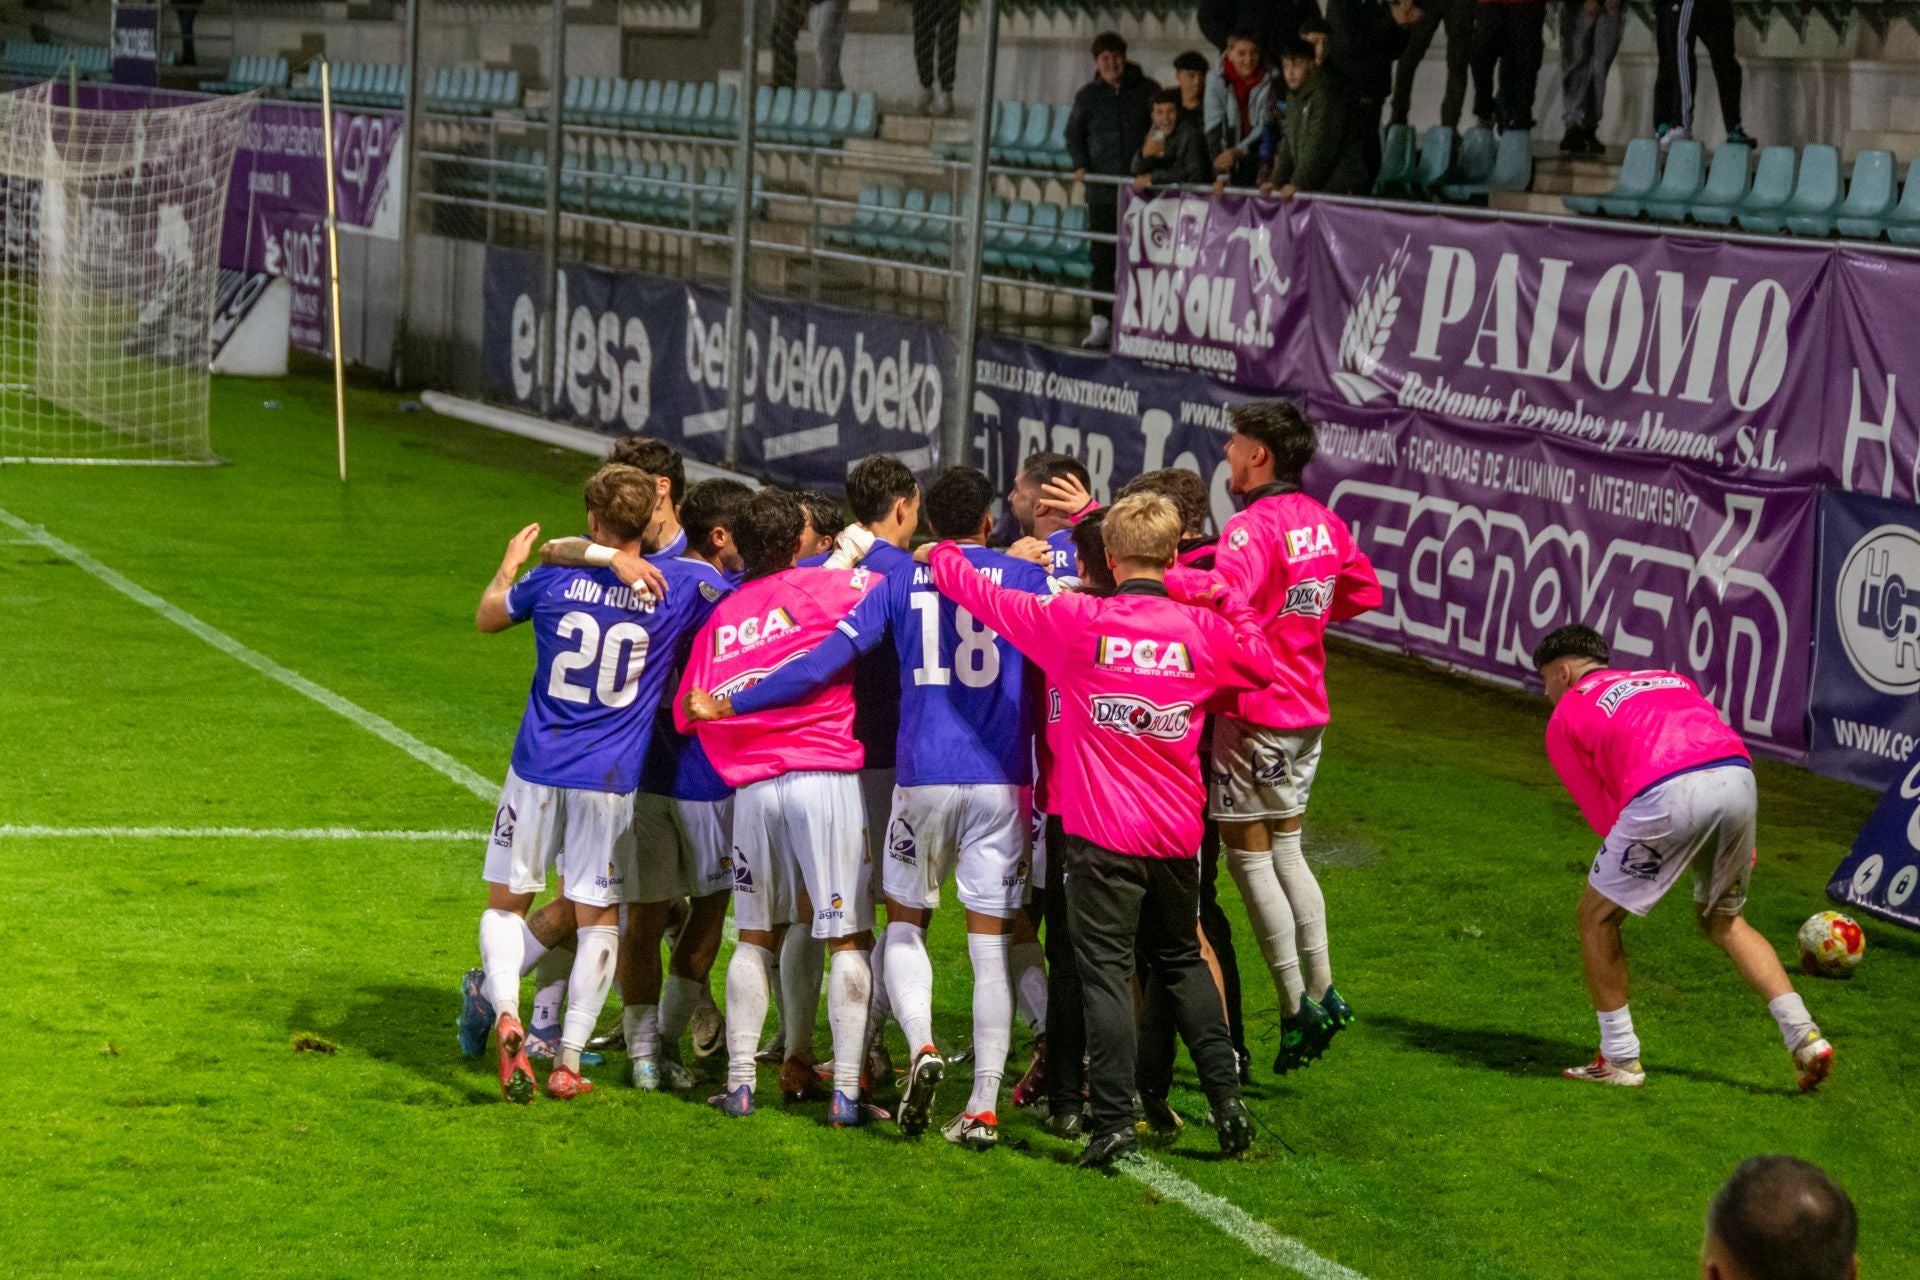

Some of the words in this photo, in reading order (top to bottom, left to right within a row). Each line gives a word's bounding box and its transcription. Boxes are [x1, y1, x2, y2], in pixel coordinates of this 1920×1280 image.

[767, 315, 847, 418] beko
[851, 331, 942, 435] beko
[1410, 244, 1791, 412] PALOMO
[1024, 371, 1045, 397] DE
[1045, 371, 1140, 416] CONSTRUCCIÓN
[1397, 371, 1503, 421] Baltanás
[1504, 388, 1606, 440] Cereales
[1601, 419, 1627, 452] y
[1628, 410, 1725, 467] Abonos,
[1733, 425, 1788, 473] S.L.
[1842, 367, 1920, 504] H
[1319, 419, 1398, 467] ROTULACIÓN
[1408, 436, 1481, 485] FACHADAS
[1483, 451, 1505, 489] DE
[1504, 457, 1576, 505] ALUMINIO
[1588, 473, 1700, 532] INTERIORISMO
[563, 578, 603, 604] JAVI
[718, 608, 792, 655] PCA
[910, 591, 1000, 688] 18
[547, 610, 650, 708] 20
[1094, 663, 1131, 673] PALENCIA
[1134, 667, 1161, 677] CRISTO
[1104, 636, 1188, 671] PCA
